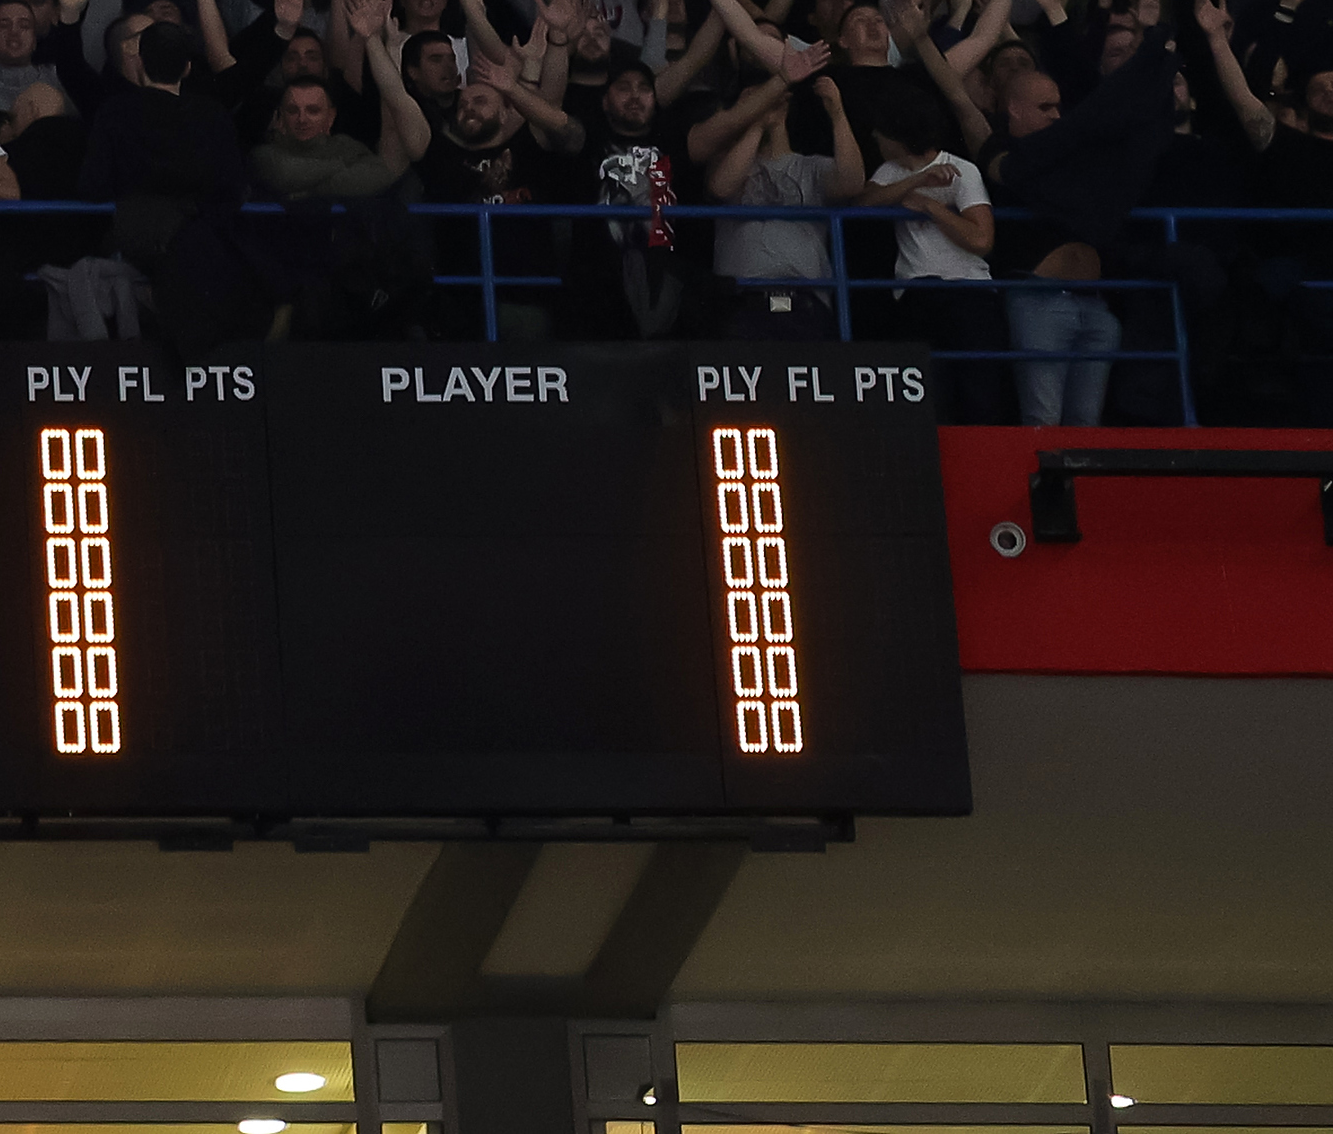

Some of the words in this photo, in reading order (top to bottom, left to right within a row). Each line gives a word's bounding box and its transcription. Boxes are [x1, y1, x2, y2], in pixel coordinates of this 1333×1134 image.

[28, 367, 93, 402] PLY
[119, 367, 166, 403] FL
[187, 367, 256, 402] PTS
[382, 368, 570, 403] PLAYER
[698, 367, 763, 402] PLY
[788, 367, 836, 403] FL
[855, 368, 926, 403] PTS
[41, 429, 107, 481] 00
[713, 429, 780, 481] 00
[44, 483, 110, 535] 00
[718, 482, 784, 535] 00
[47, 537, 113, 590] 00
[723, 537, 790, 590] 00
[49, 590, 116, 645] 00
[728, 590, 794, 645] 00
[53, 645, 119, 700] 00
[732, 645, 799, 700] 00
[55, 700, 122, 755] 00
[737, 700, 804, 754] 00
